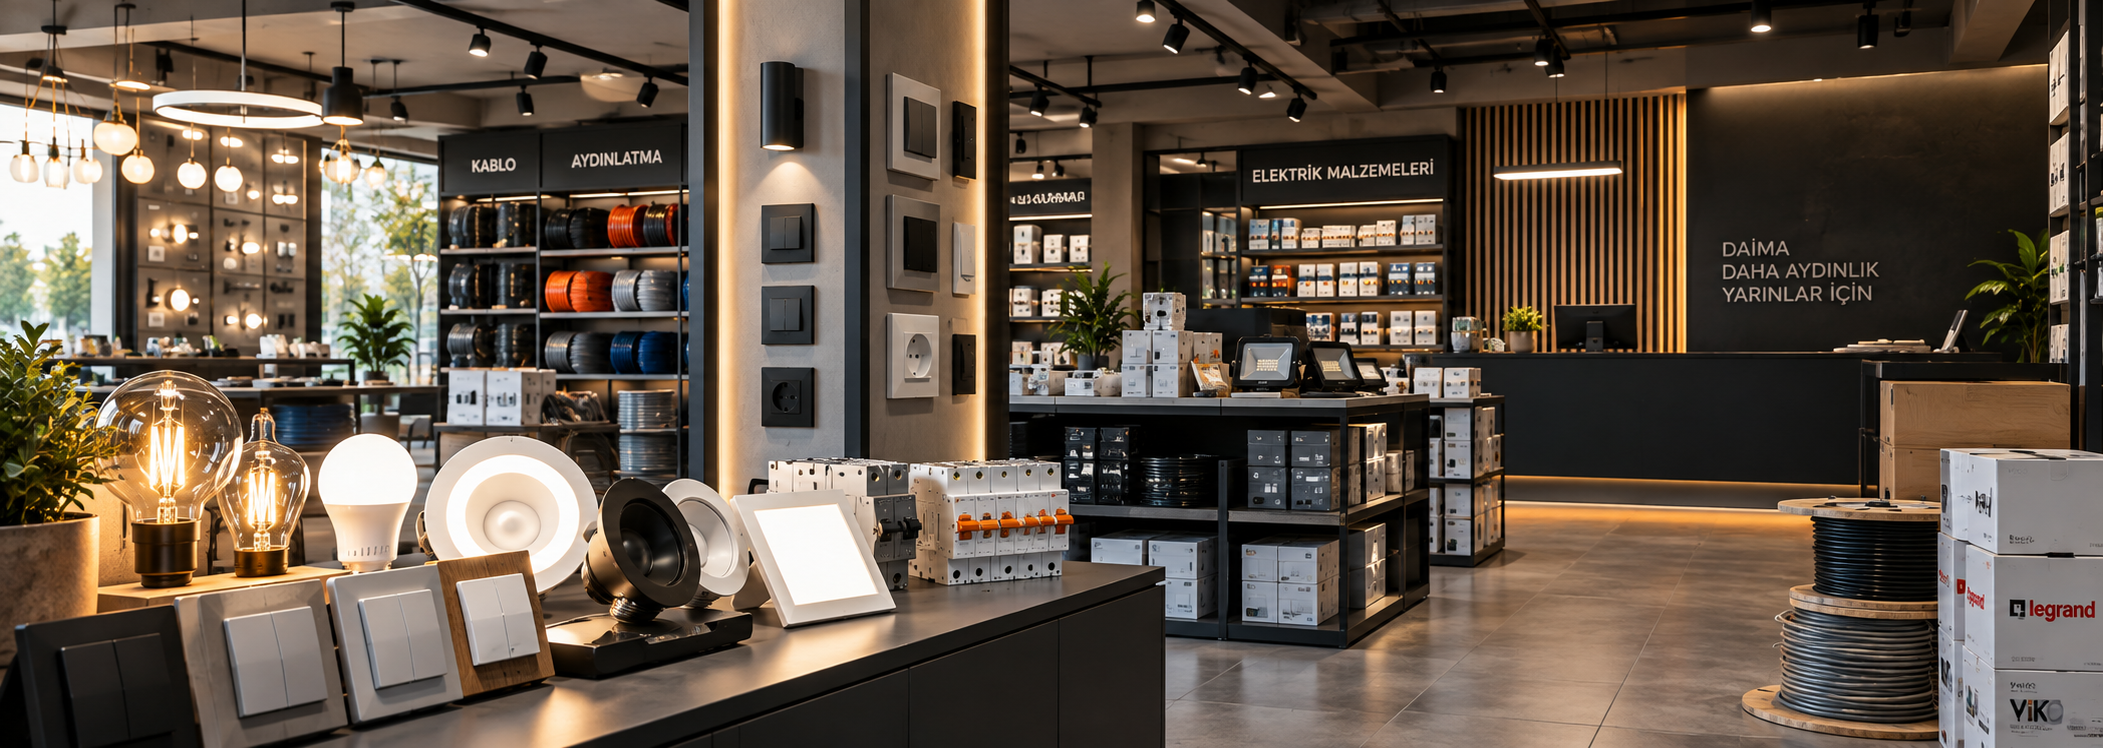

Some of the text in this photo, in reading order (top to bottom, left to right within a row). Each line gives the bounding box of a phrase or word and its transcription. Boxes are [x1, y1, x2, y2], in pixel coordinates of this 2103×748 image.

[471, 157, 517, 174] KABLO
[571, 149, 663, 169] AYDINLATMA
[1252, 158, 1434, 183] ELEKTRİK MALZEMELERİ
[1722, 237, 1790, 257] DAİMA
[1722, 261, 1879, 280] DAHA AYDINLIK
[1722, 281, 1872, 306] YARINLAR İÇİN
[2029, 599, 2096, 623] legrand
